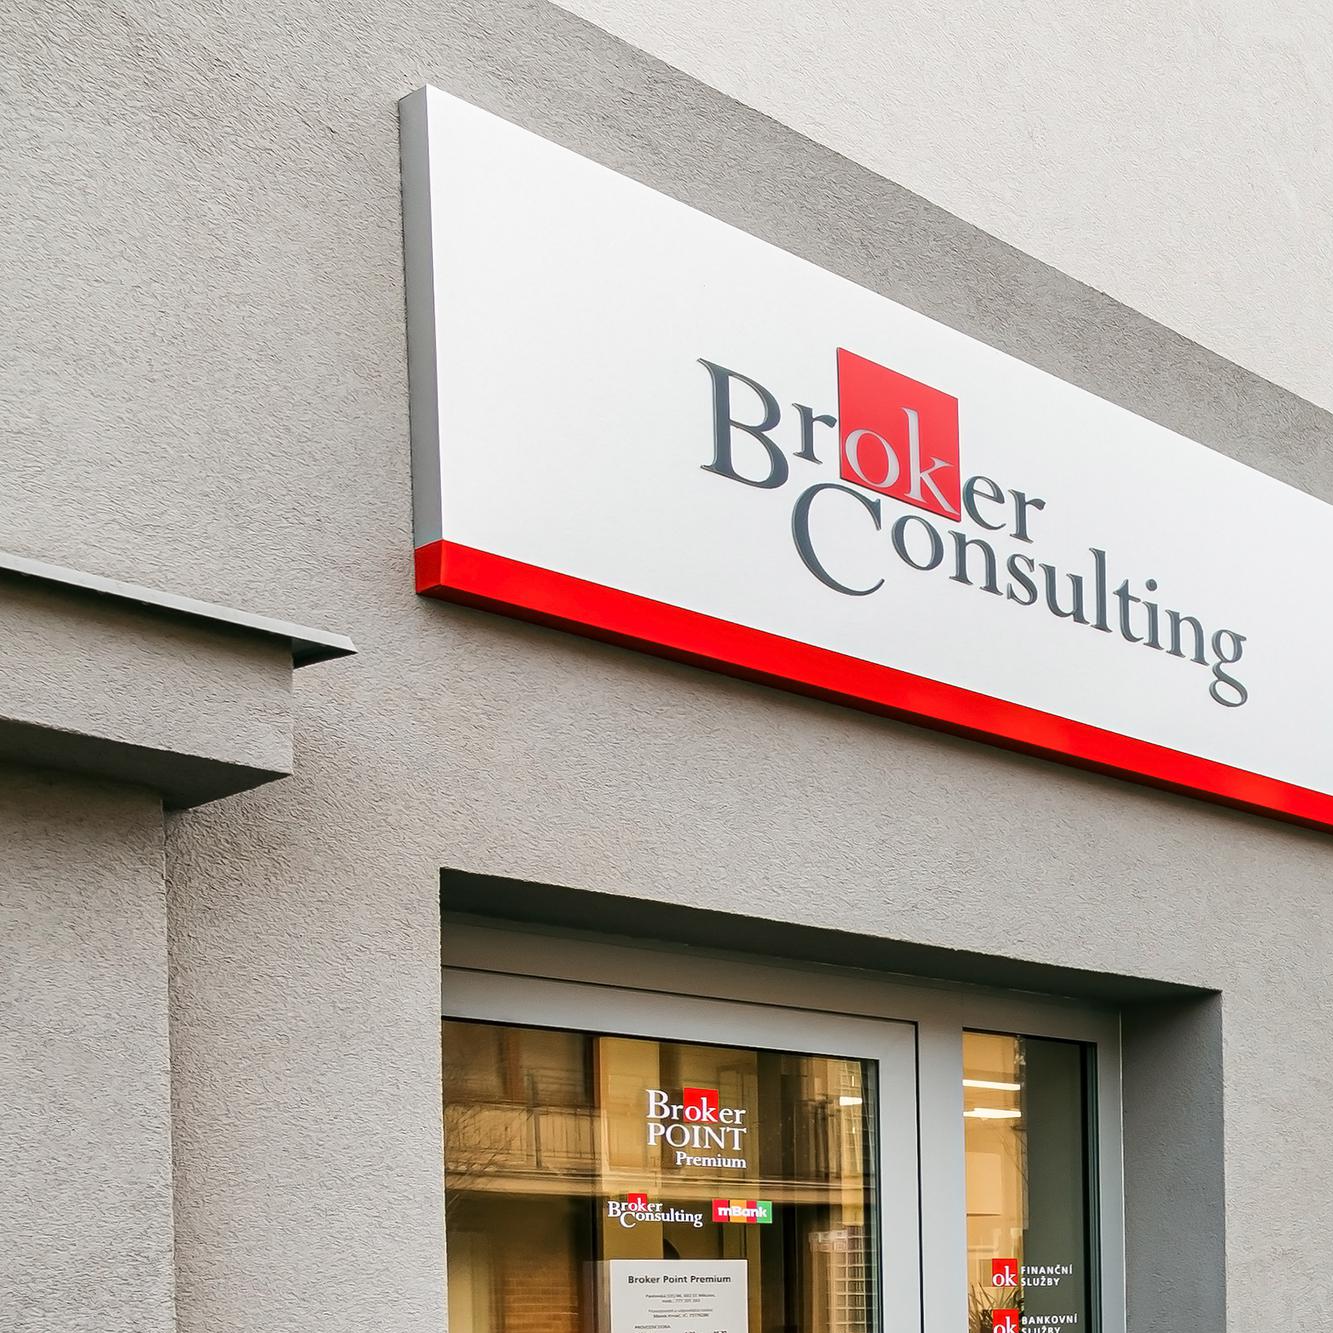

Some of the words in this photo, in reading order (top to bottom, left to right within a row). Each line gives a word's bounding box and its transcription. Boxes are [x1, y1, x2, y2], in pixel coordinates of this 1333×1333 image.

[697, 358, 1046, 543] Broker
[791, 483, 1249, 708] Consulting
[645, 1088, 747, 1126] Broker
[646, 1123, 748, 1151] POINT
[675, 1151, 748, 1169] Premium
[607, 1197, 663, 1218] Broker
[620, 1207, 703, 1228] Consulting
[717, 1205, 768, 1218] mBank
[628, 1275, 660, 1284] Broker
[663, 1275, 688, 1284] Point
[690, 1275, 731, 1283] Premium
[992, 1265, 1017, 1287] ok
[1020, 1264, 1073, 1275] FINANČNÍ
[1020, 1276, 1061, 1287] SLUŽBY
[1021, 1313, 1078, 1325] BANKOVNÍ
